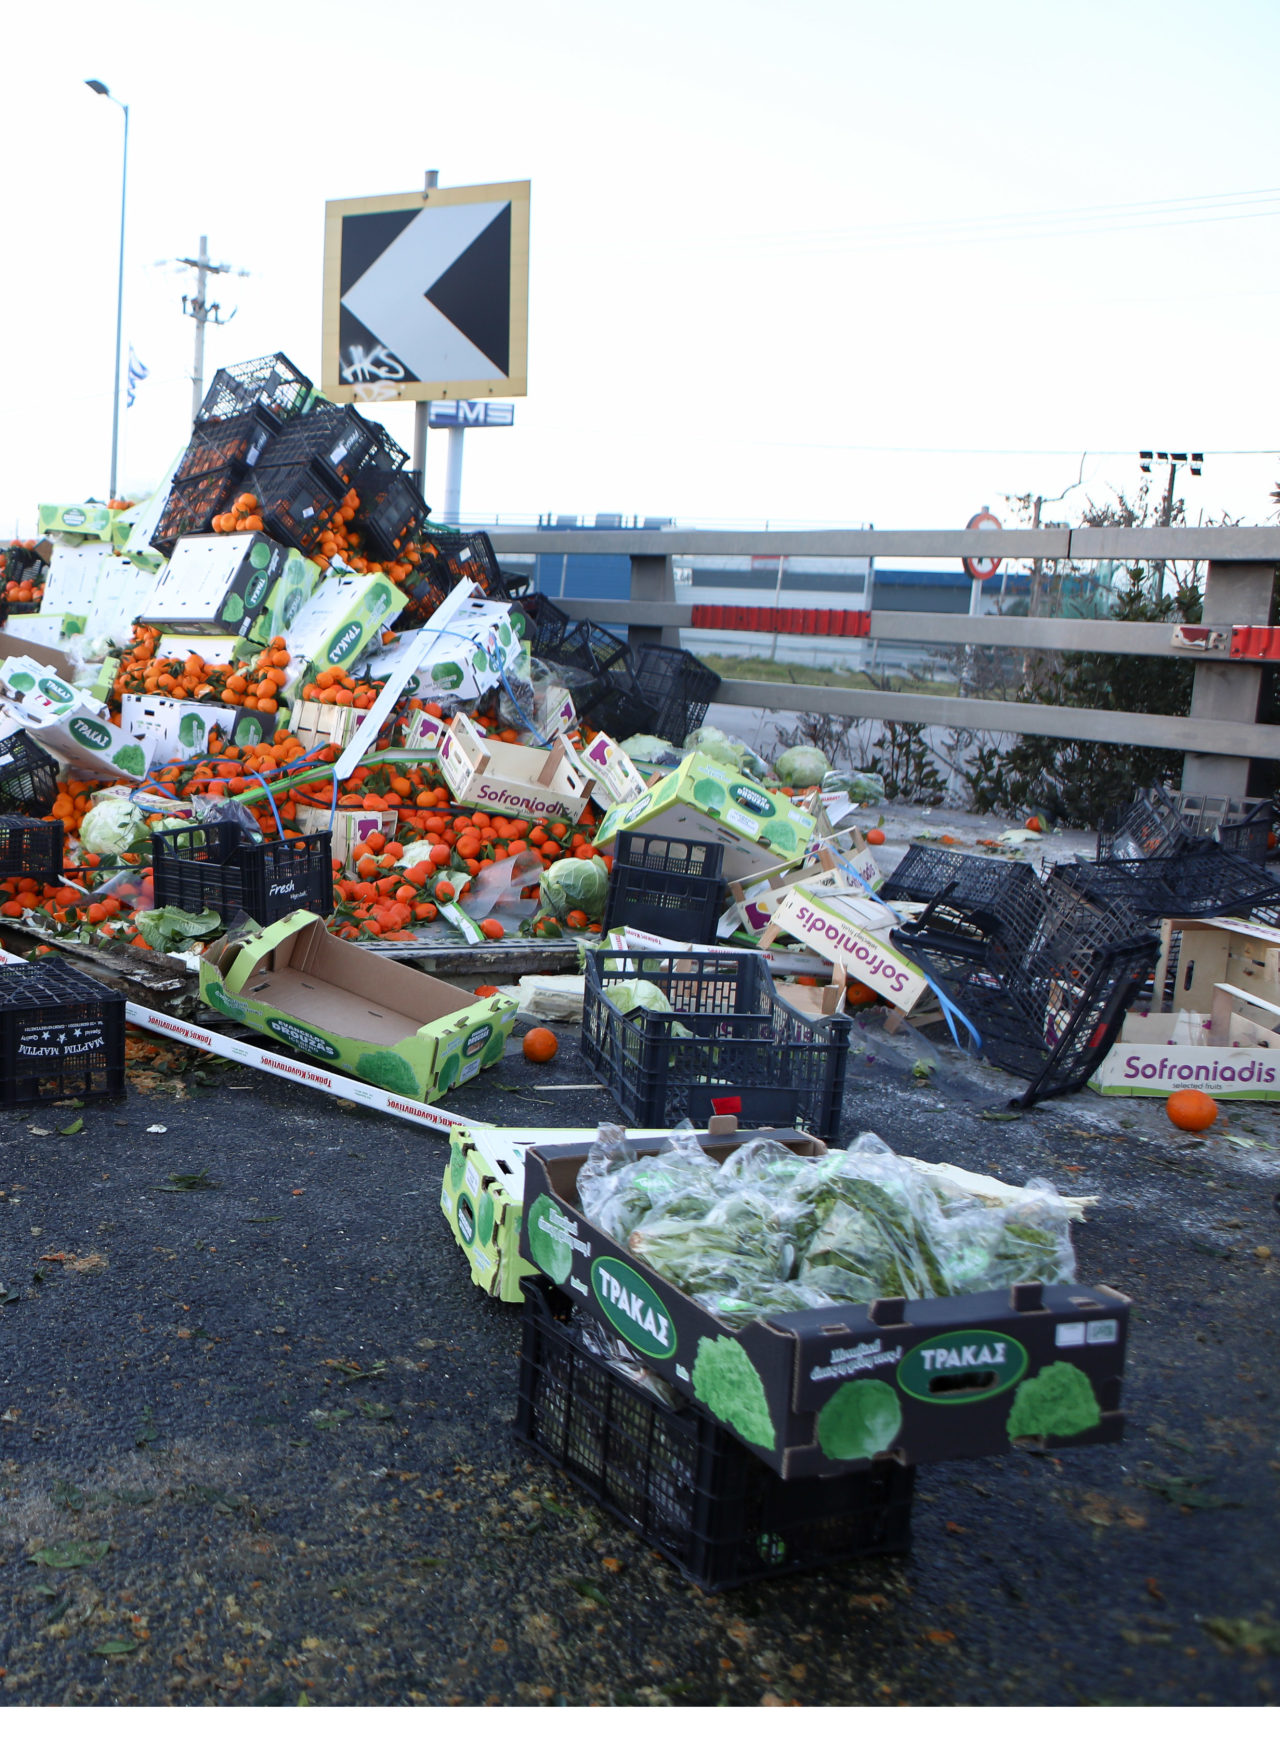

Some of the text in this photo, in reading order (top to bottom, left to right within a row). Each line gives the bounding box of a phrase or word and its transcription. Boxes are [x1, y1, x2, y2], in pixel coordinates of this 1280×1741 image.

[329, 624, 361, 663] ΤΡΑΚΑΣ
[45, 680, 71, 700] ΤΡΑΚΑΣ
[73, 719, 109, 747] ΤΡΑΚΑΣ
[269, 880, 295, 896] Fresh
[796, 907, 910, 992] Sofroniadis
[271, 1022, 334, 1056] DROUZAS
[1124, 1055, 1276, 1083] Sofroniadis
[1172, 1082, 1203, 1090] selected
[598, 1268, 671, 1349] ΤΡΑΚΑΣ
[920, 1342, 1007, 1370] ΤΡΑΚΑΣ
